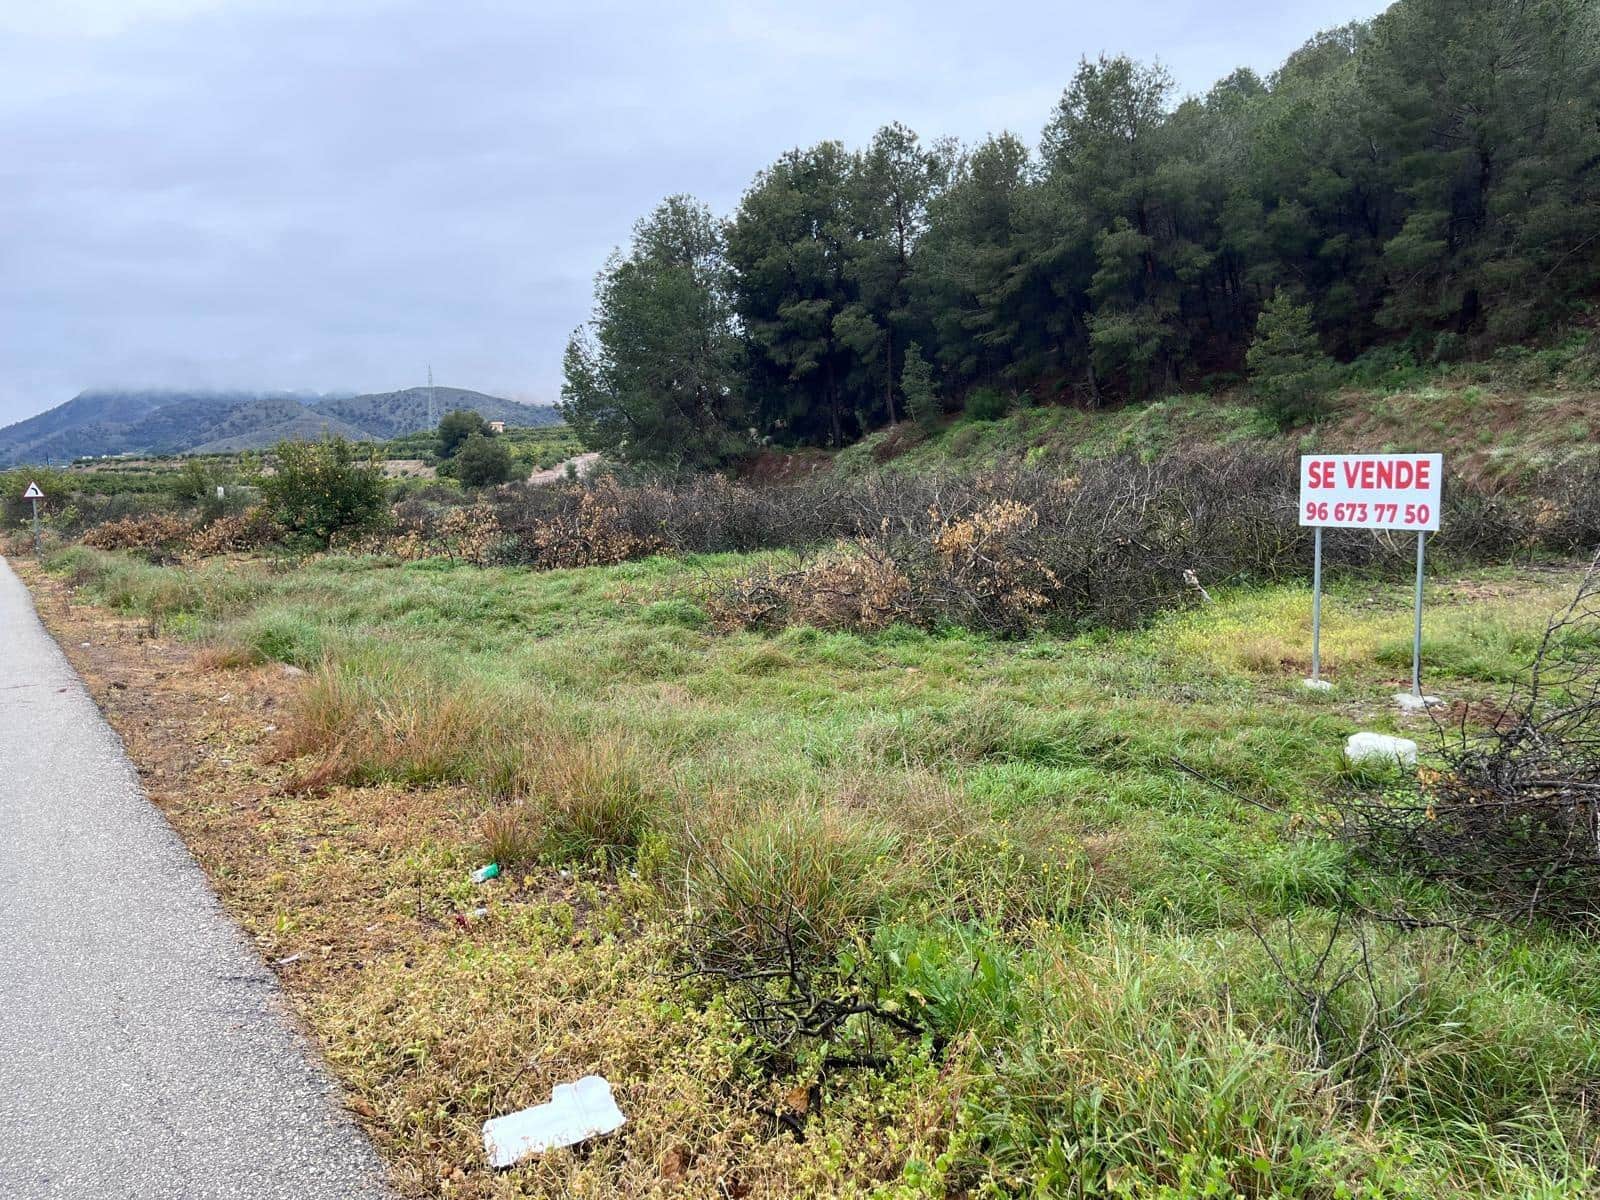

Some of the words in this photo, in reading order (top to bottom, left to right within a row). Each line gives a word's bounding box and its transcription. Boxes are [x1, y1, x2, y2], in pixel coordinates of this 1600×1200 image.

[1308, 461, 1336, 489] SE
[1343, 460, 1430, 489] VENDE
[1306, 502, 1328, 521] 96
[1334, 502, 1368, 522] 673
[1374, 504, 1398, 523] 77
[1404, 504, 1430, 524] 50
